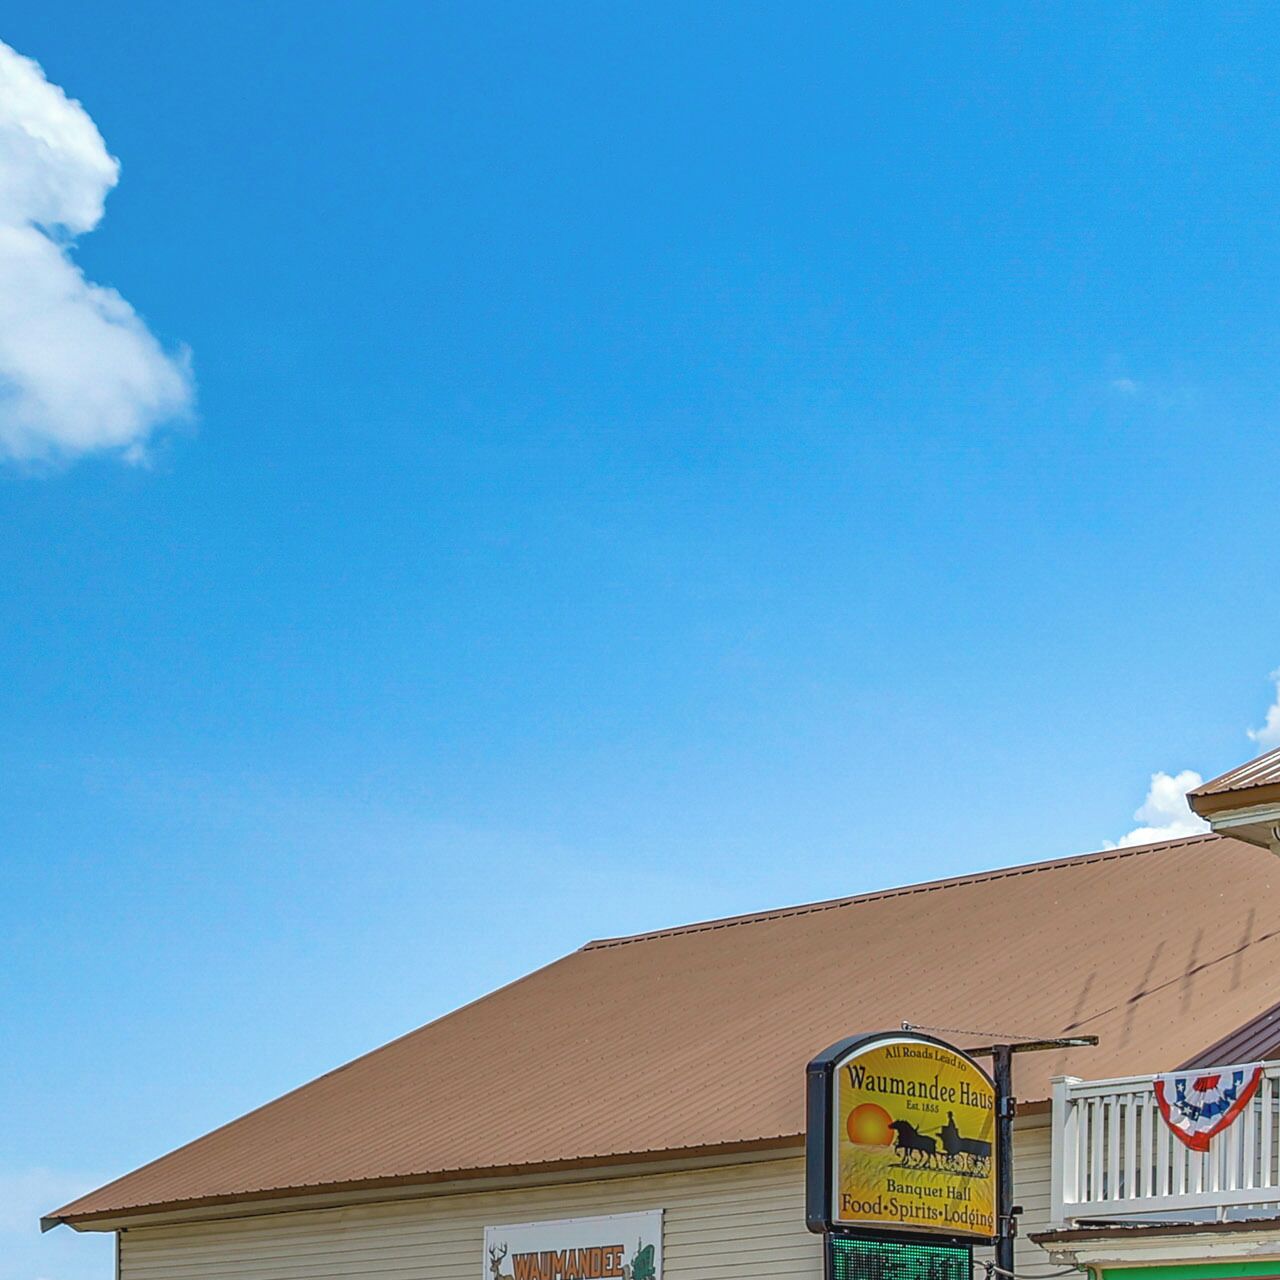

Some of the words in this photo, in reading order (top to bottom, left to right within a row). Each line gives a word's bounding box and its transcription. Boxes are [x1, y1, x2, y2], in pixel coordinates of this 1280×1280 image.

[885, 1045, 901, 1059] All
[902, 1047, 933, 1060] Roads
[935, 1050, 957, 1067] Lead
[958, 1061, 967, 1072] to
[846, 1063, 956, 1103] Waumandee
[906, 1099, 921, 1111] Est.
[922, 1103, 939, 1114] 1855
[886, 1178, 943, 1199] Banquet
[946, 1186, 971, 1202] Hall
